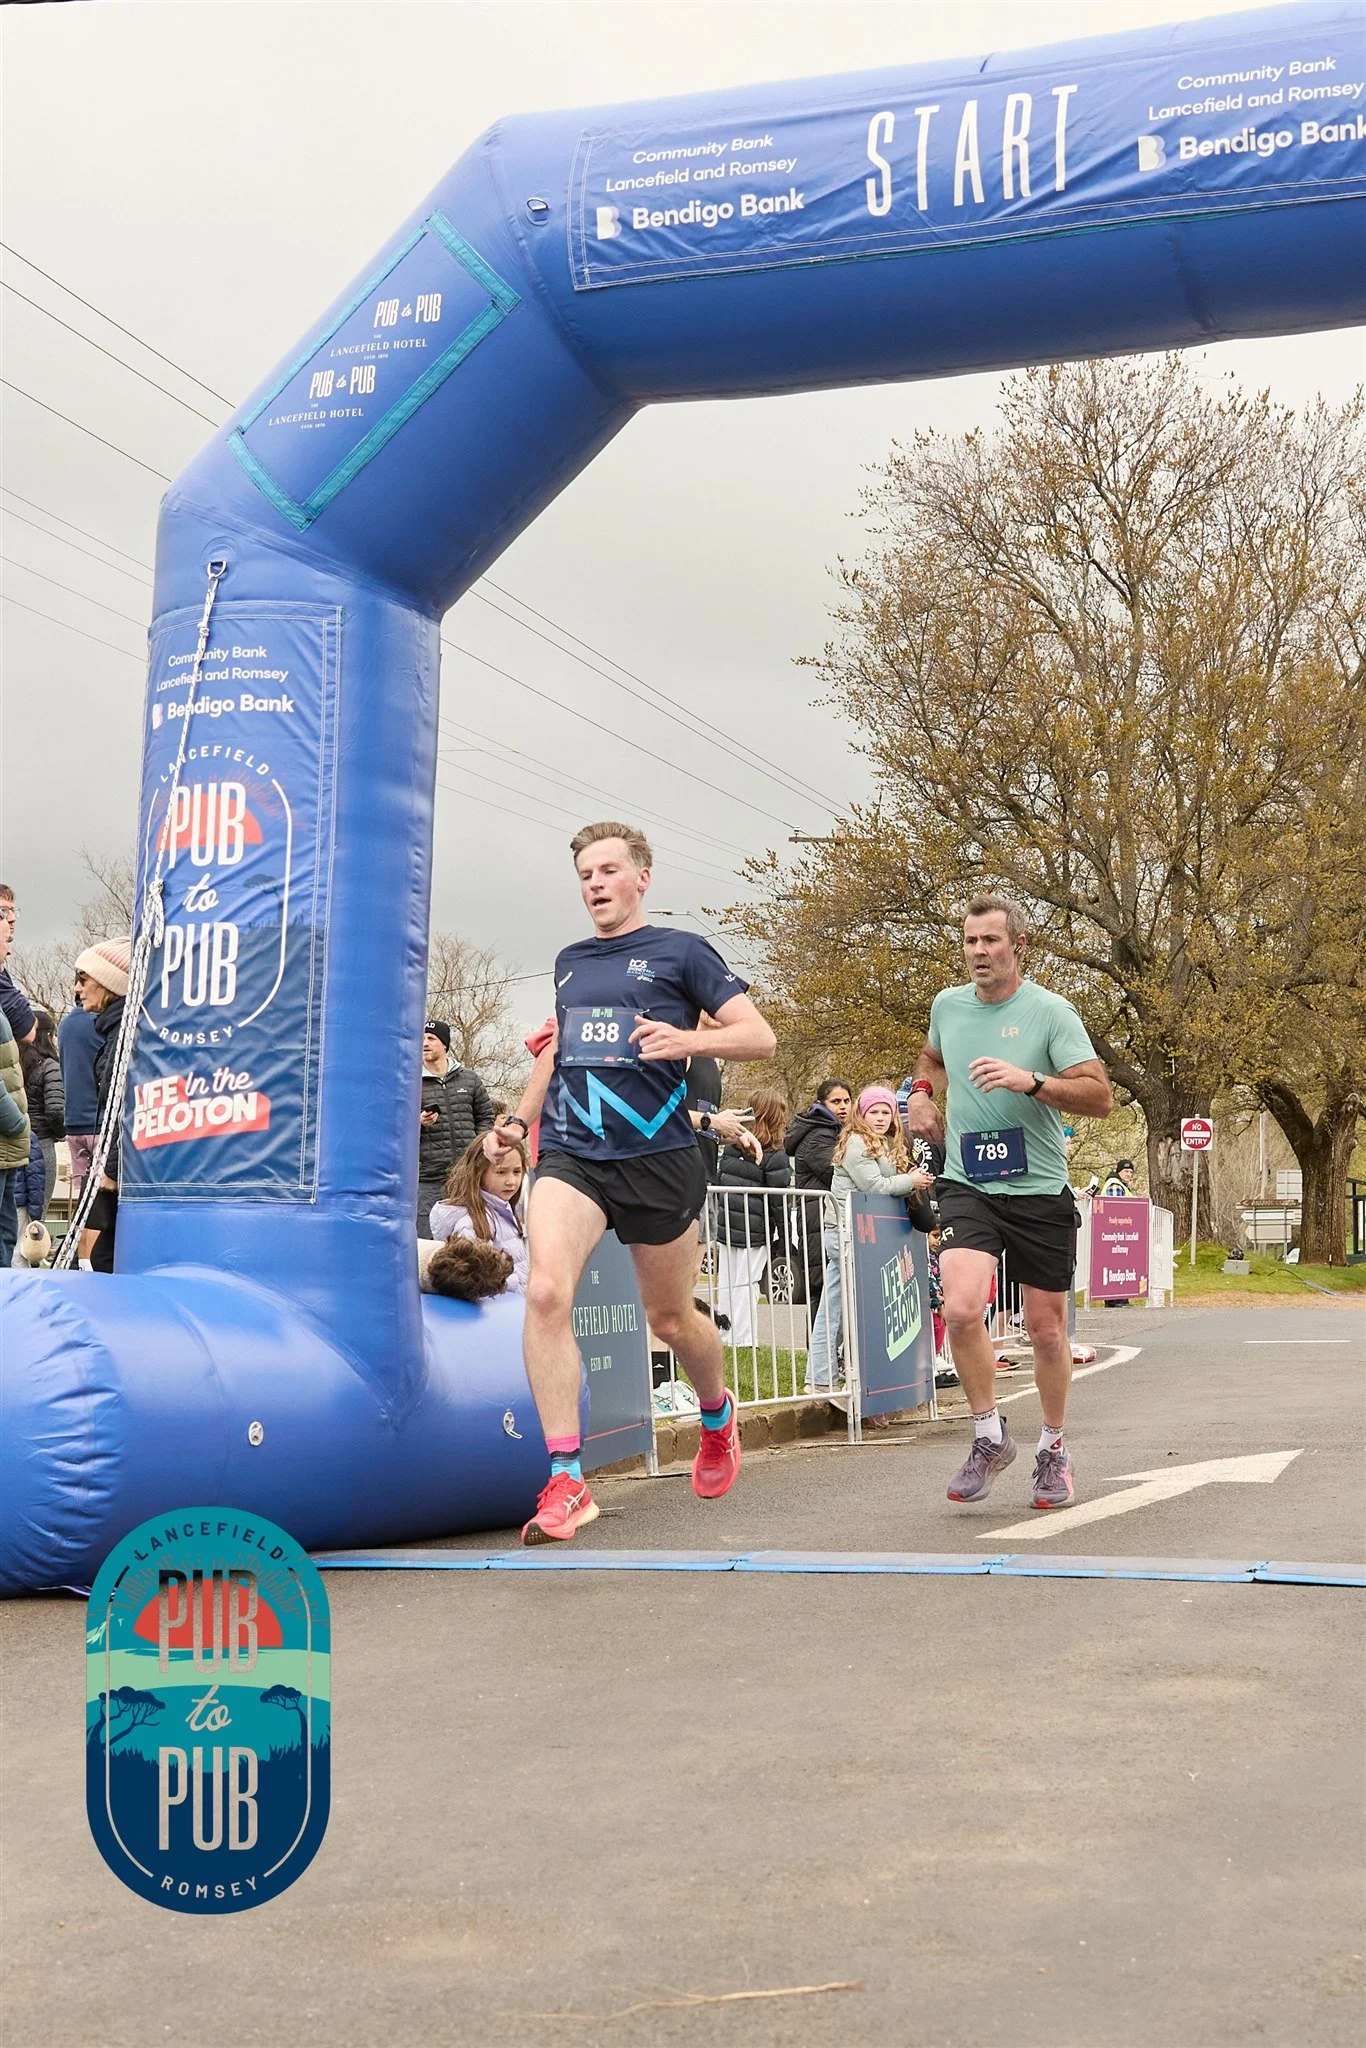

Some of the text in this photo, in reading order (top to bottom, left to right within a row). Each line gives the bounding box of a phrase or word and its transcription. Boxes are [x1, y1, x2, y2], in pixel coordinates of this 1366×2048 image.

[1177, 56, 1336, 90] Community Bank
[1149, 82, 1365, 121] Lancefield and Romsey
[632, 134, 774, 165] Community Bank
[865, 84, 1079, 217] START
[1179, 127, 1293, 160] Bendigo
[1301, 114, 1366, 145] Bank
[605, 157, 798, 193] Lancefield and Romsey
[632, 200, 734, 230] Bendigo
[740, 188, 805, 217] Bank
[373, 298, 400, 329] PUB
[414, 293, 442, 324] PUB
[330, 341, 390, 358] LANCEFIELD
[393, 338, 428, 349] HOTEL
[308, 370, 335, 399] PUB
[349, 365, 376, 395] PUB
[268, 410, 327, 426] LANCEFIELD
[329, 407, 365, 419] HOTEL
[232, 646, 268, 659] Bank
[156, 667, 289, 692] Lancefied and Romsey
[239, 694, 295, 713] Bank
[167, 782, 247, 870] PUB
[181, 873, 219, 913] to
[161, 921, 239, 1008] PUB
[158, 1025, 233, 1045] ROMSEY
[581, 1022, 620, 1043] 838
[133, 1074, 180, 1114] LIFE
[212, 1067, 254, 1093] the
[131, 1091, 258, 1141] PELOTON
[1191, 1122, 1203, 1131] NO
[974, 1142, 1009, 1162] 789
[1185, 1138, 1208, 1146] ENTRY
[572, 1303, 639, 1338] CEFIELD HOTEL
